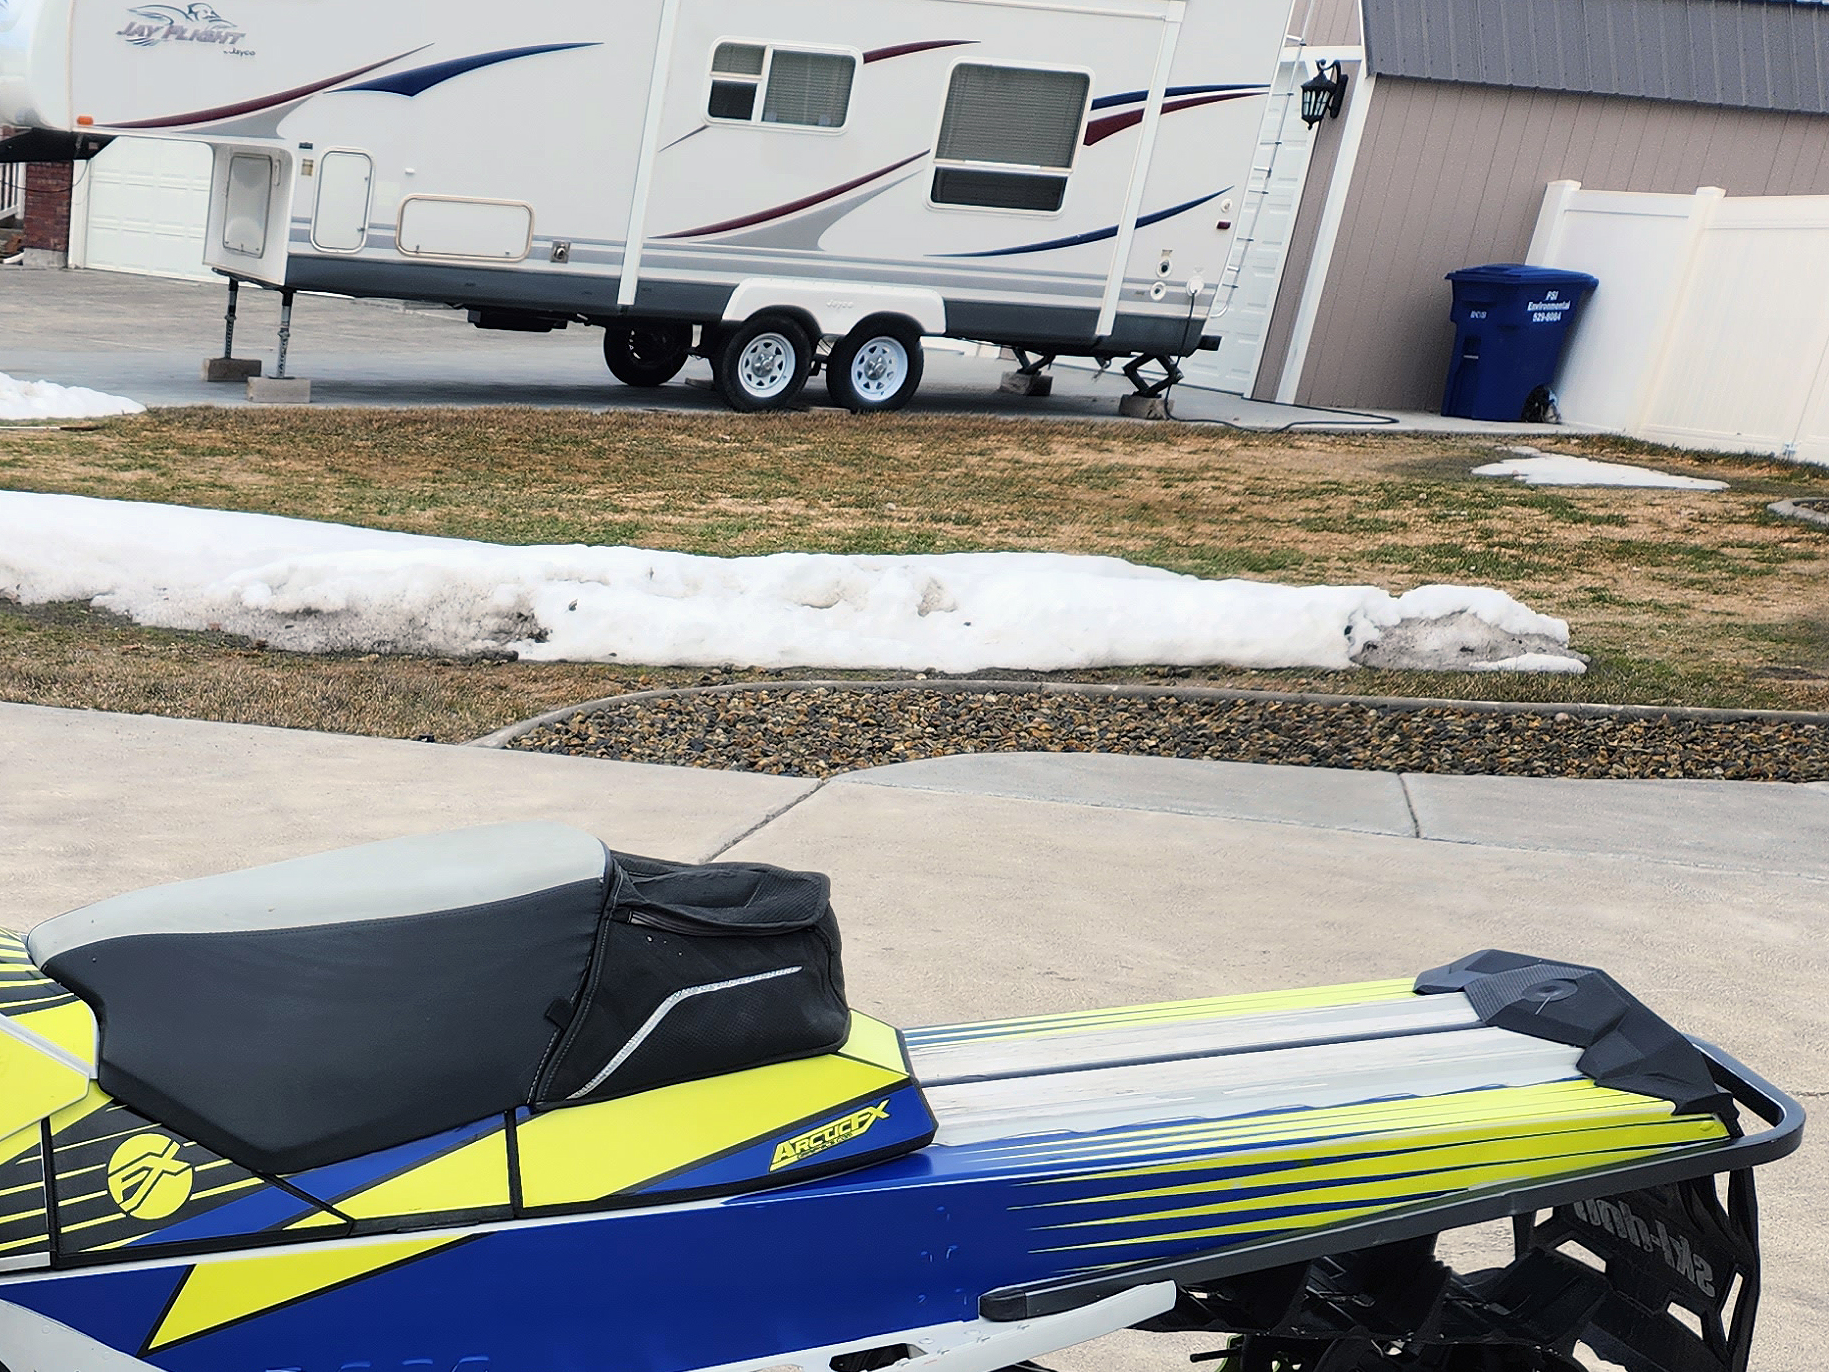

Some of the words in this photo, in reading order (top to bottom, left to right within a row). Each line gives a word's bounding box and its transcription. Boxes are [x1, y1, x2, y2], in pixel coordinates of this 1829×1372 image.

[116, 21, 165, 38] JAY
[161, 24, 246, 45] FLIGHT
[1527, 300, 1571, 312] Environmental
